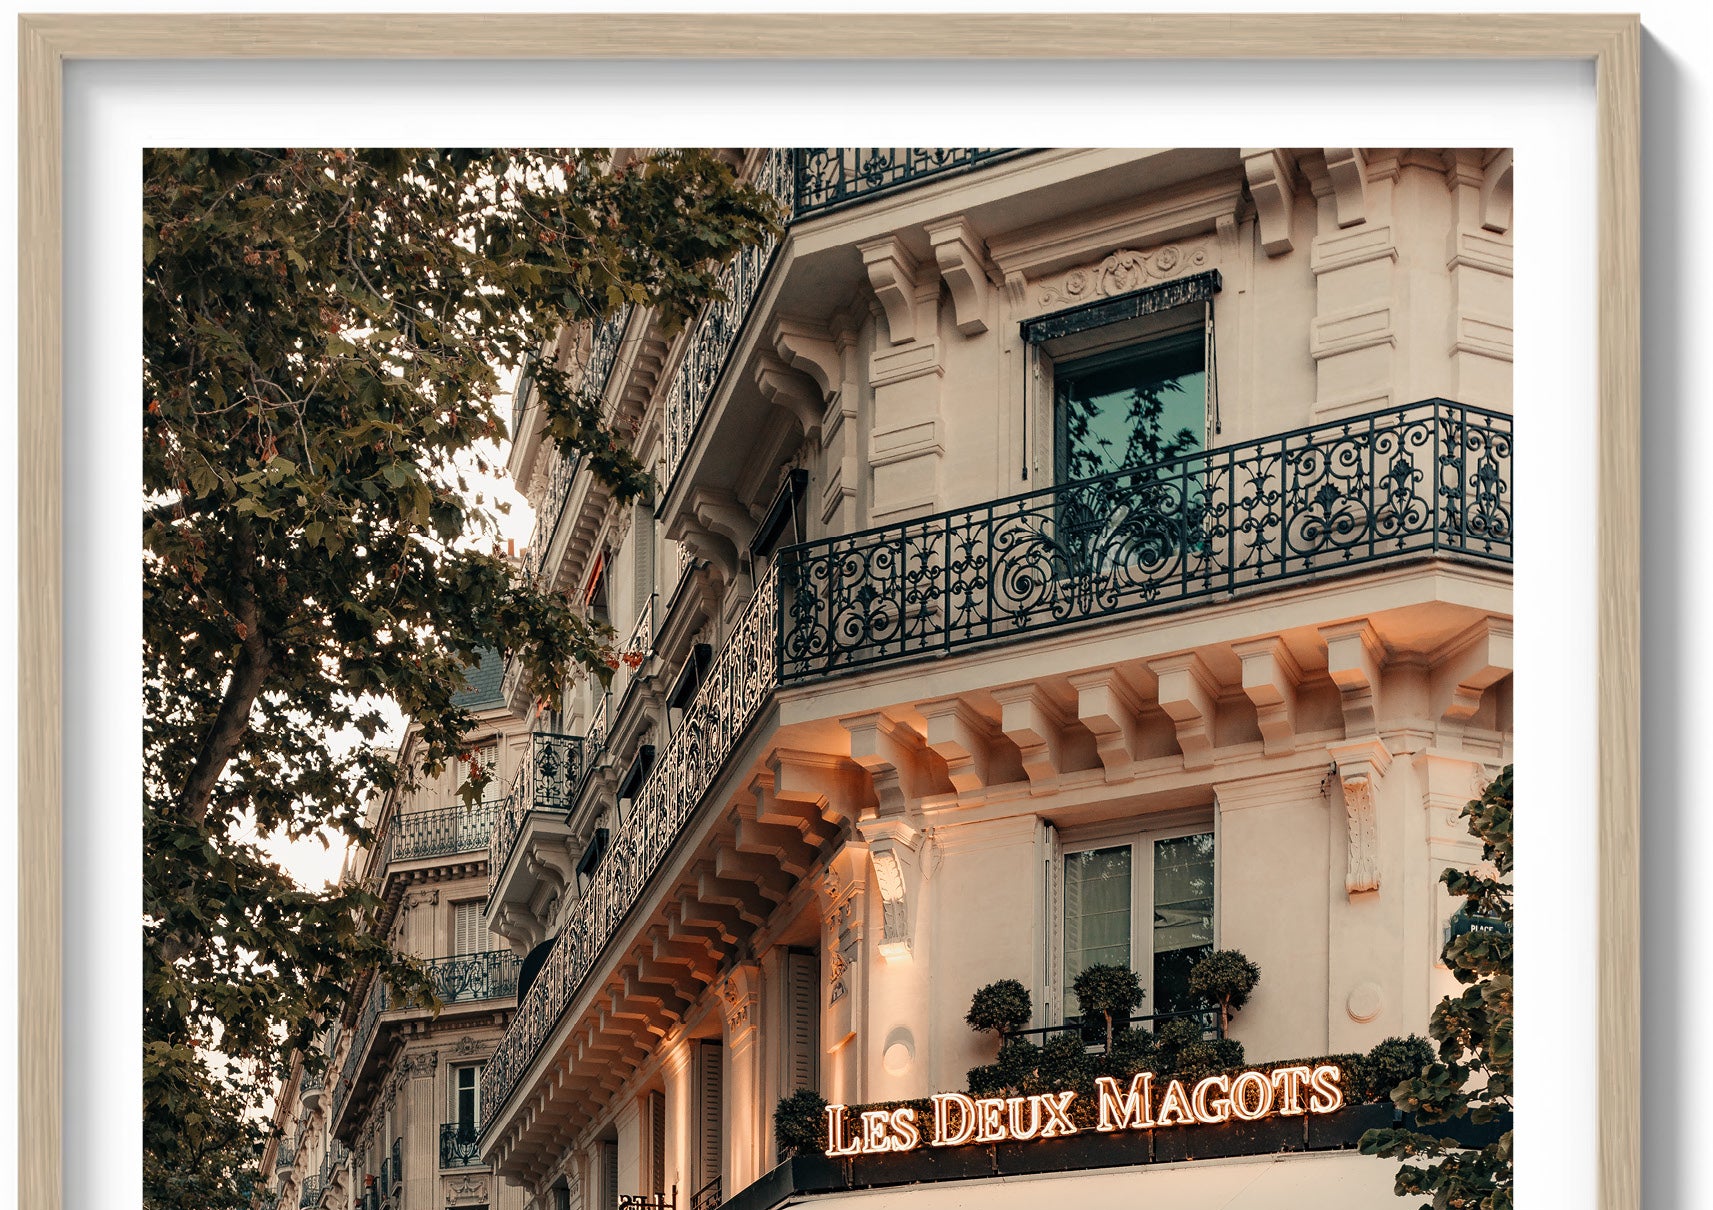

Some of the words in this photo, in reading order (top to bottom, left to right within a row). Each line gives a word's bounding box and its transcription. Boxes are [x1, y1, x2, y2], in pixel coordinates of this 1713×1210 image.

[825, 1104, 919, 1157] LES
[931, 1090, 1078, 1147] DEUX
[1095, 1065, 1344, 1132] MAGOTS
